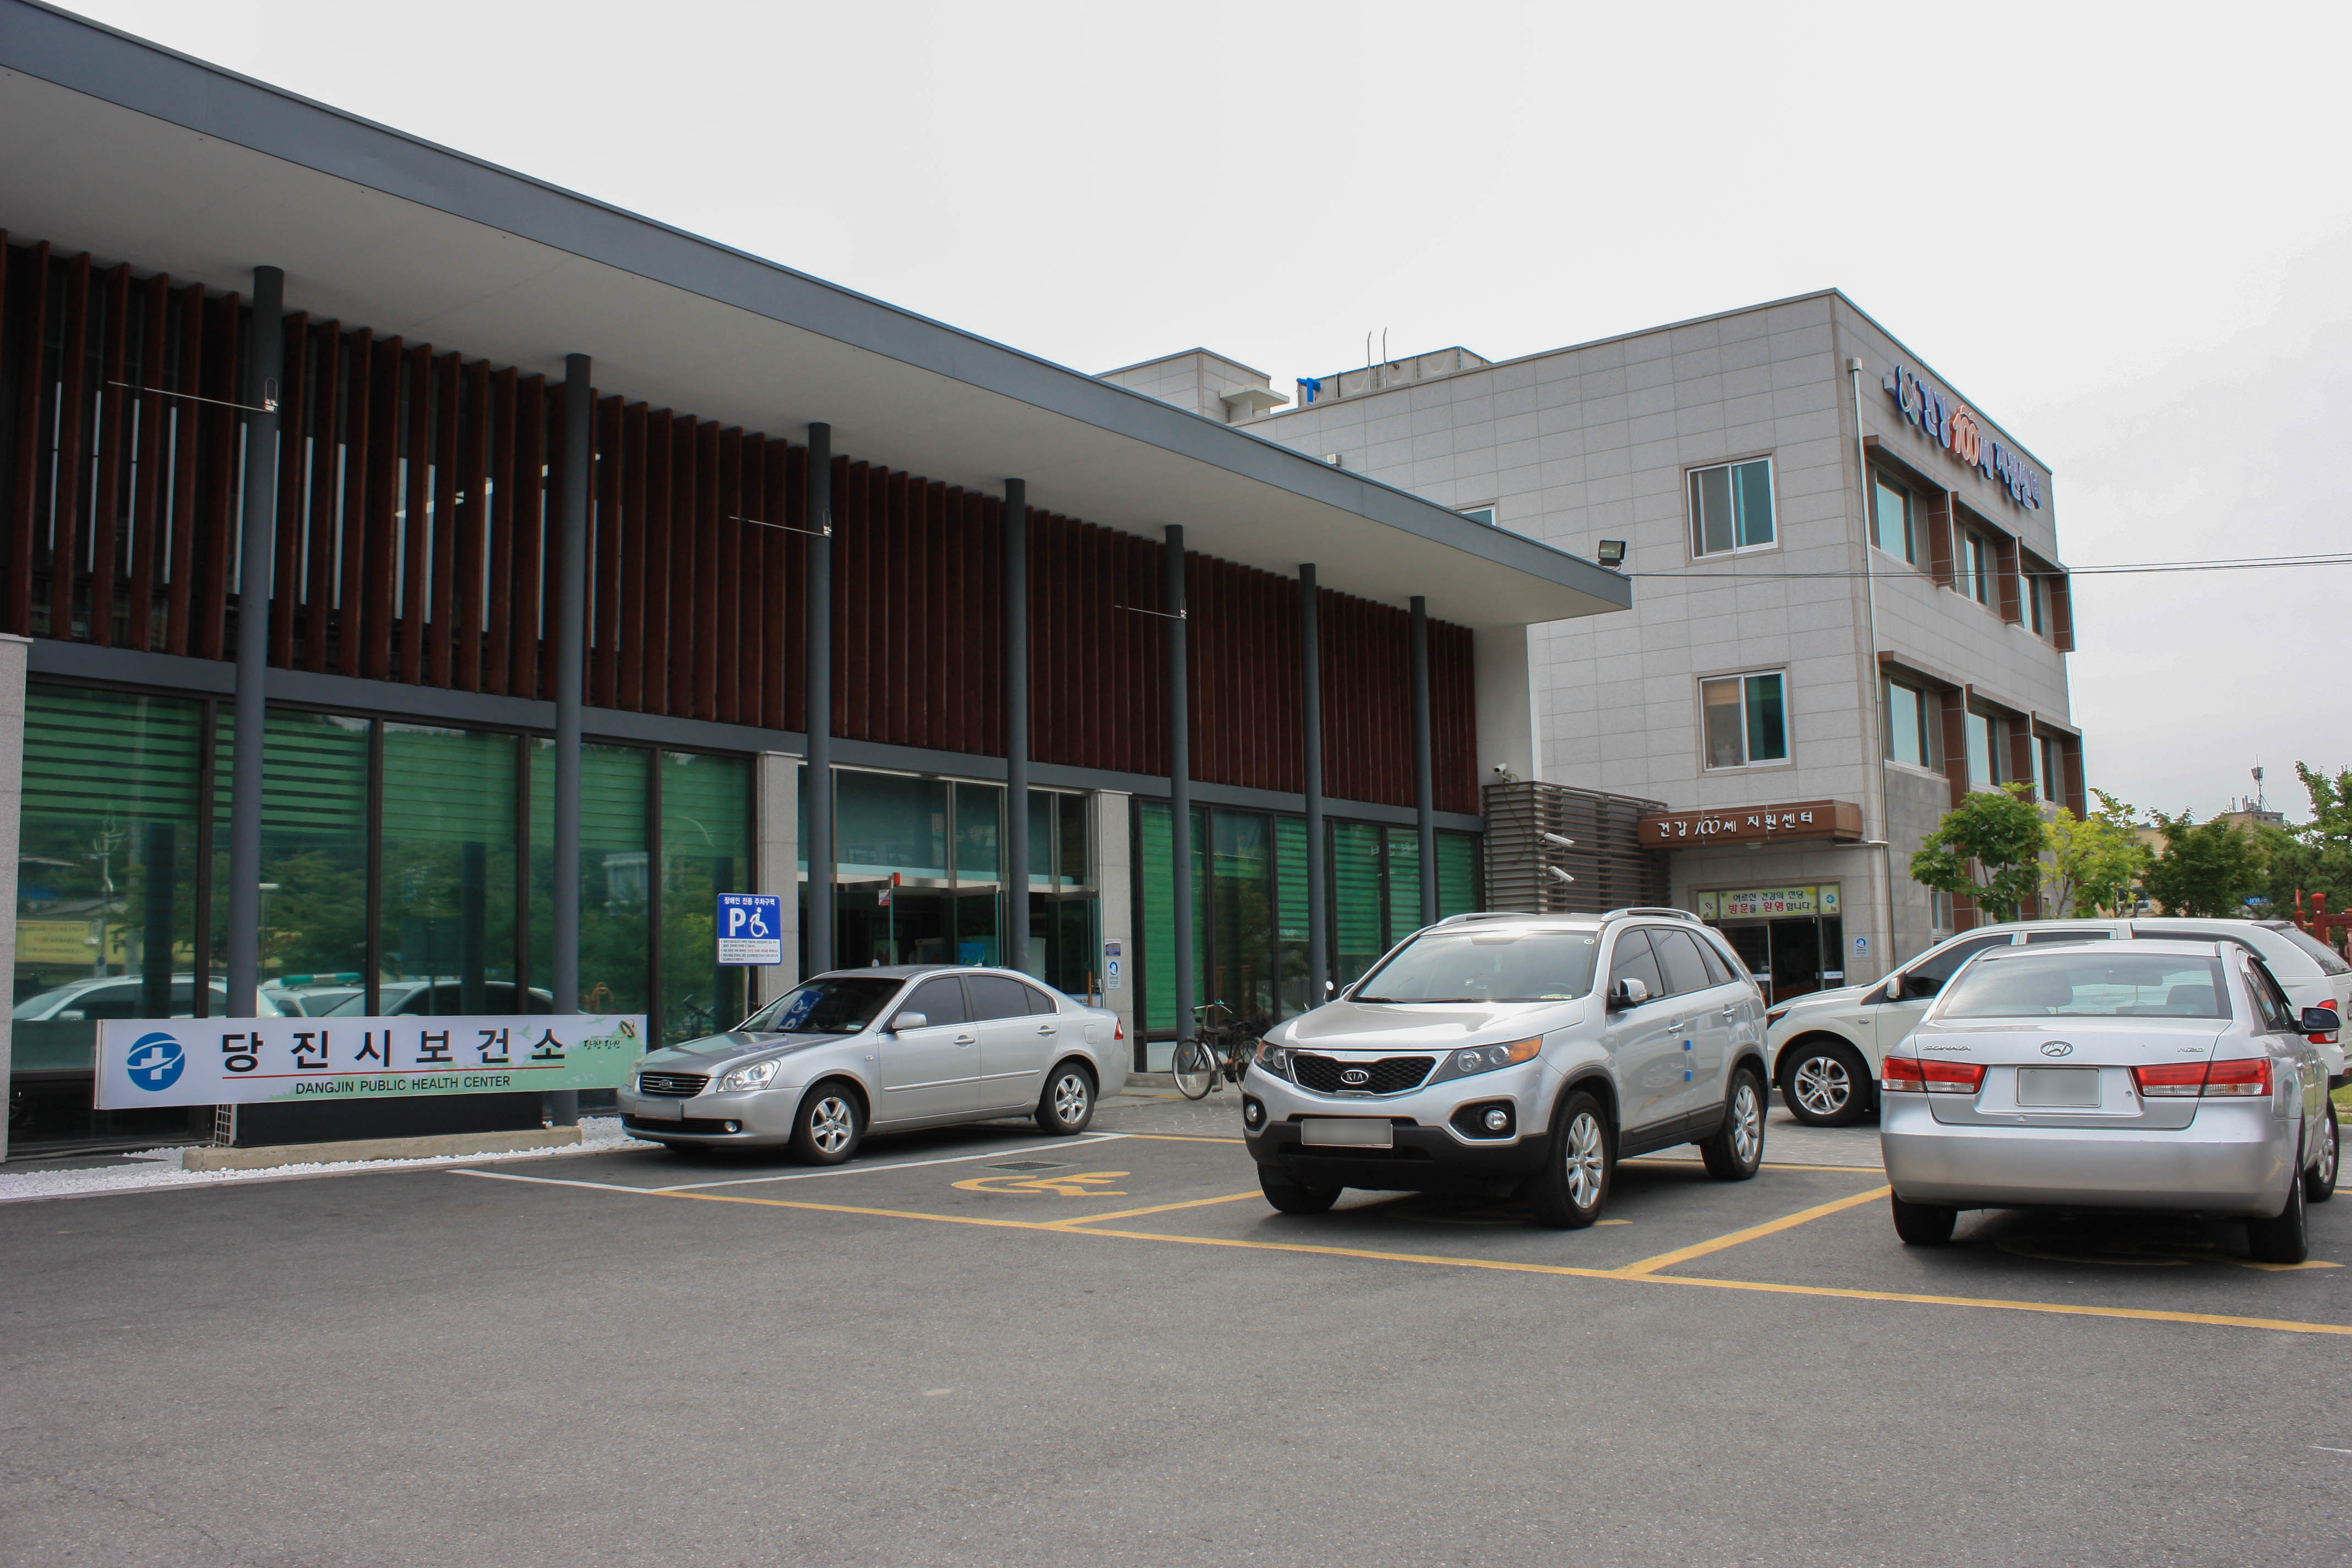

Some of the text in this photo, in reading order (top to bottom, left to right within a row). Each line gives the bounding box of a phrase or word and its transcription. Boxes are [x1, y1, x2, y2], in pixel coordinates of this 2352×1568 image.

[1657, 820, 1687, 837] 건강
[1746, 811, 1812, 830] 지원센터
[724, 896, 775, 906] 장애인 전용 주차구역
[1733, 893, 1756, 902] 어르신
[1761, 891, 1784, 901] 건강의
[1728, 901, 1810, 915] 방문을 환영합니다
[729, 908, 747, 937] P
[1346, 1072, 1364, 1081] KIA
[296, 1076, 511, 1095] DANGJIN PUBLIC HEALTH CENTER
